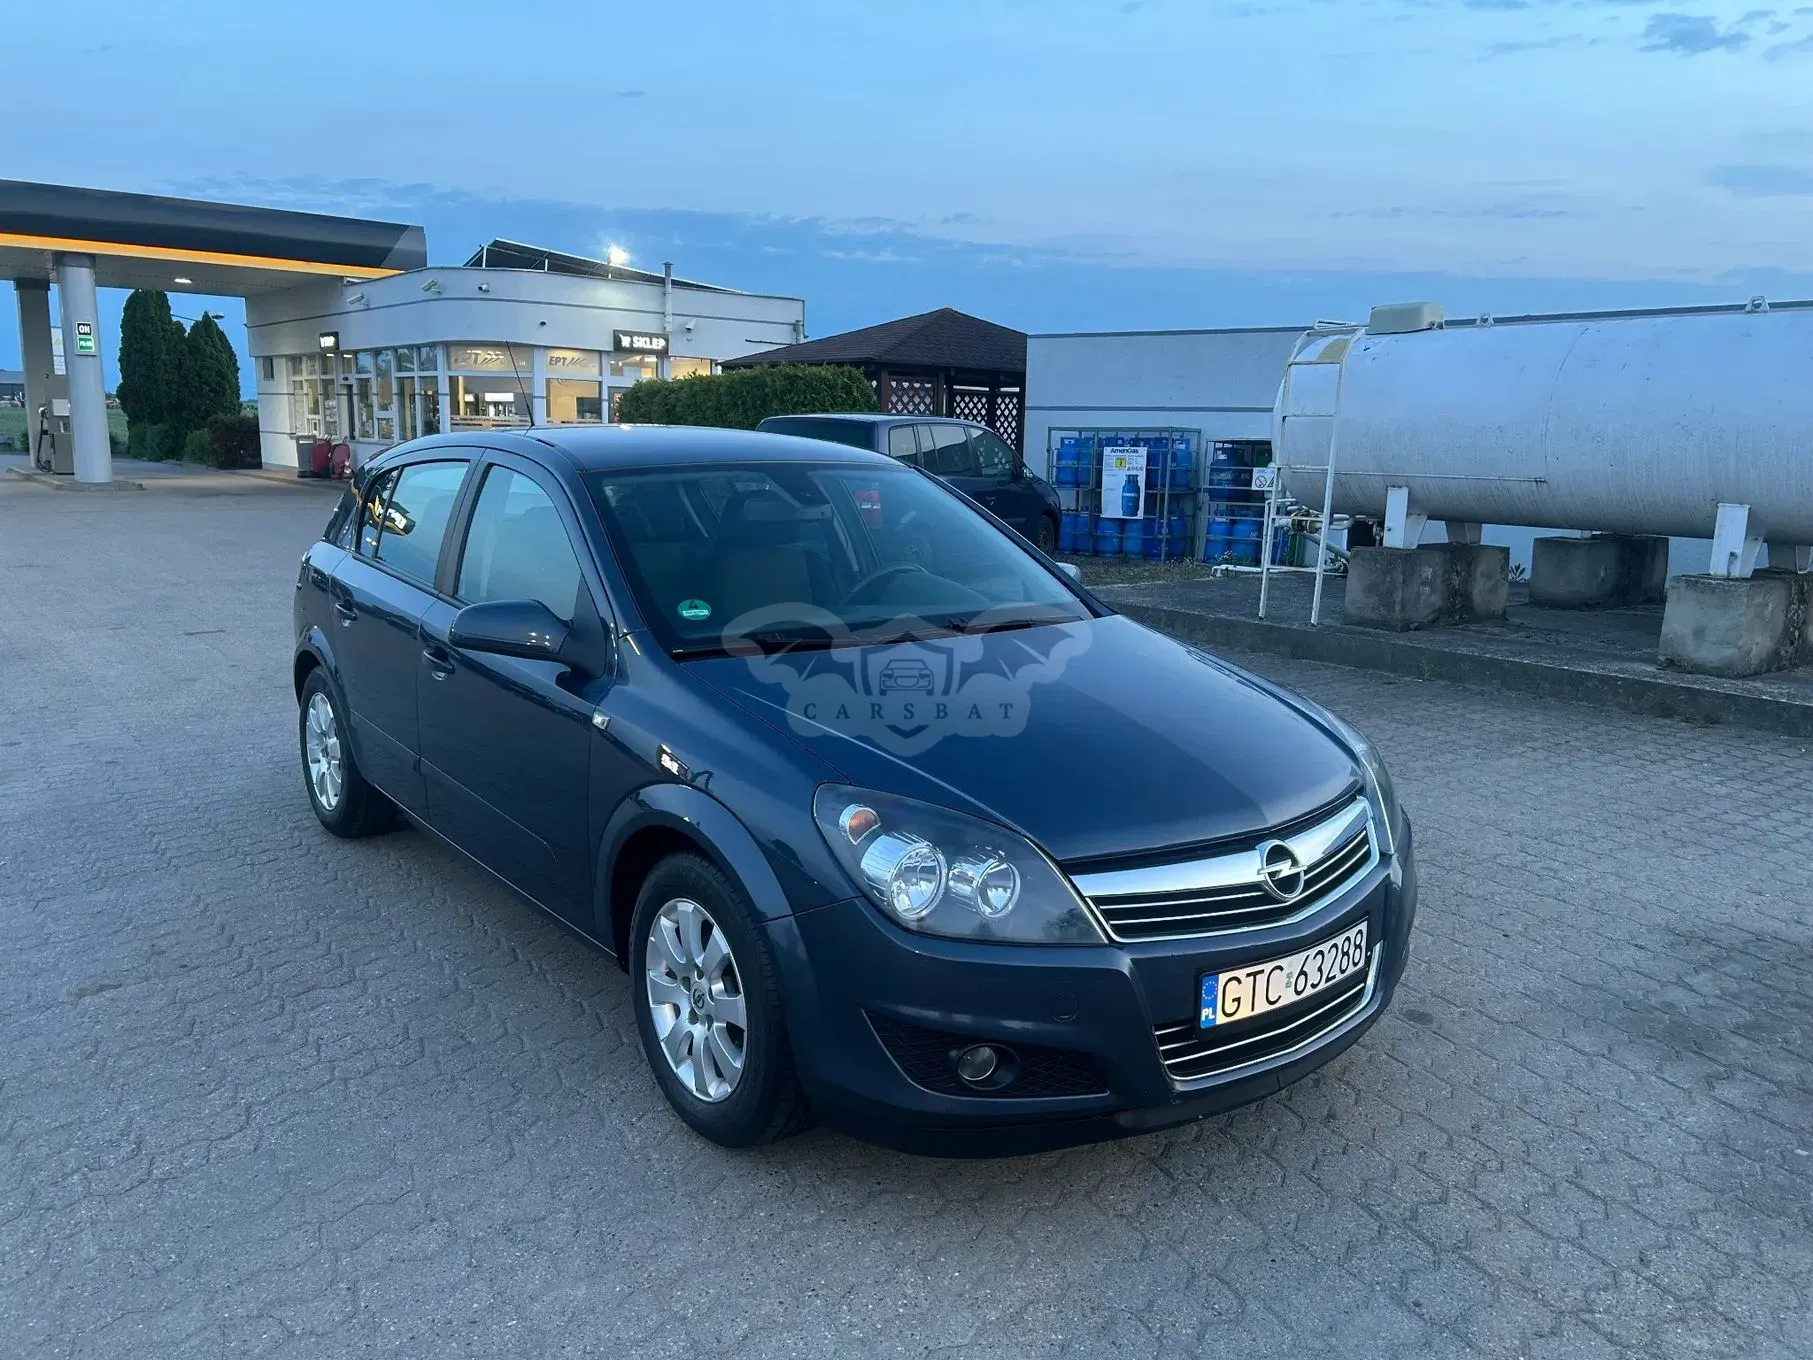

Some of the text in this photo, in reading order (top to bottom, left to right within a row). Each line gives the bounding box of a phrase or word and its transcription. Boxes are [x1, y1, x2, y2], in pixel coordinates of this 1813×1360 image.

[79, 325, 90, 333] ON
[632, 335, 666, 350] SKLEP
[550, 356, 566, 366] EPT
[1222, 929, 1363, 1017] GTC 63288
[1201, 1008, 1216, 1021] PL
